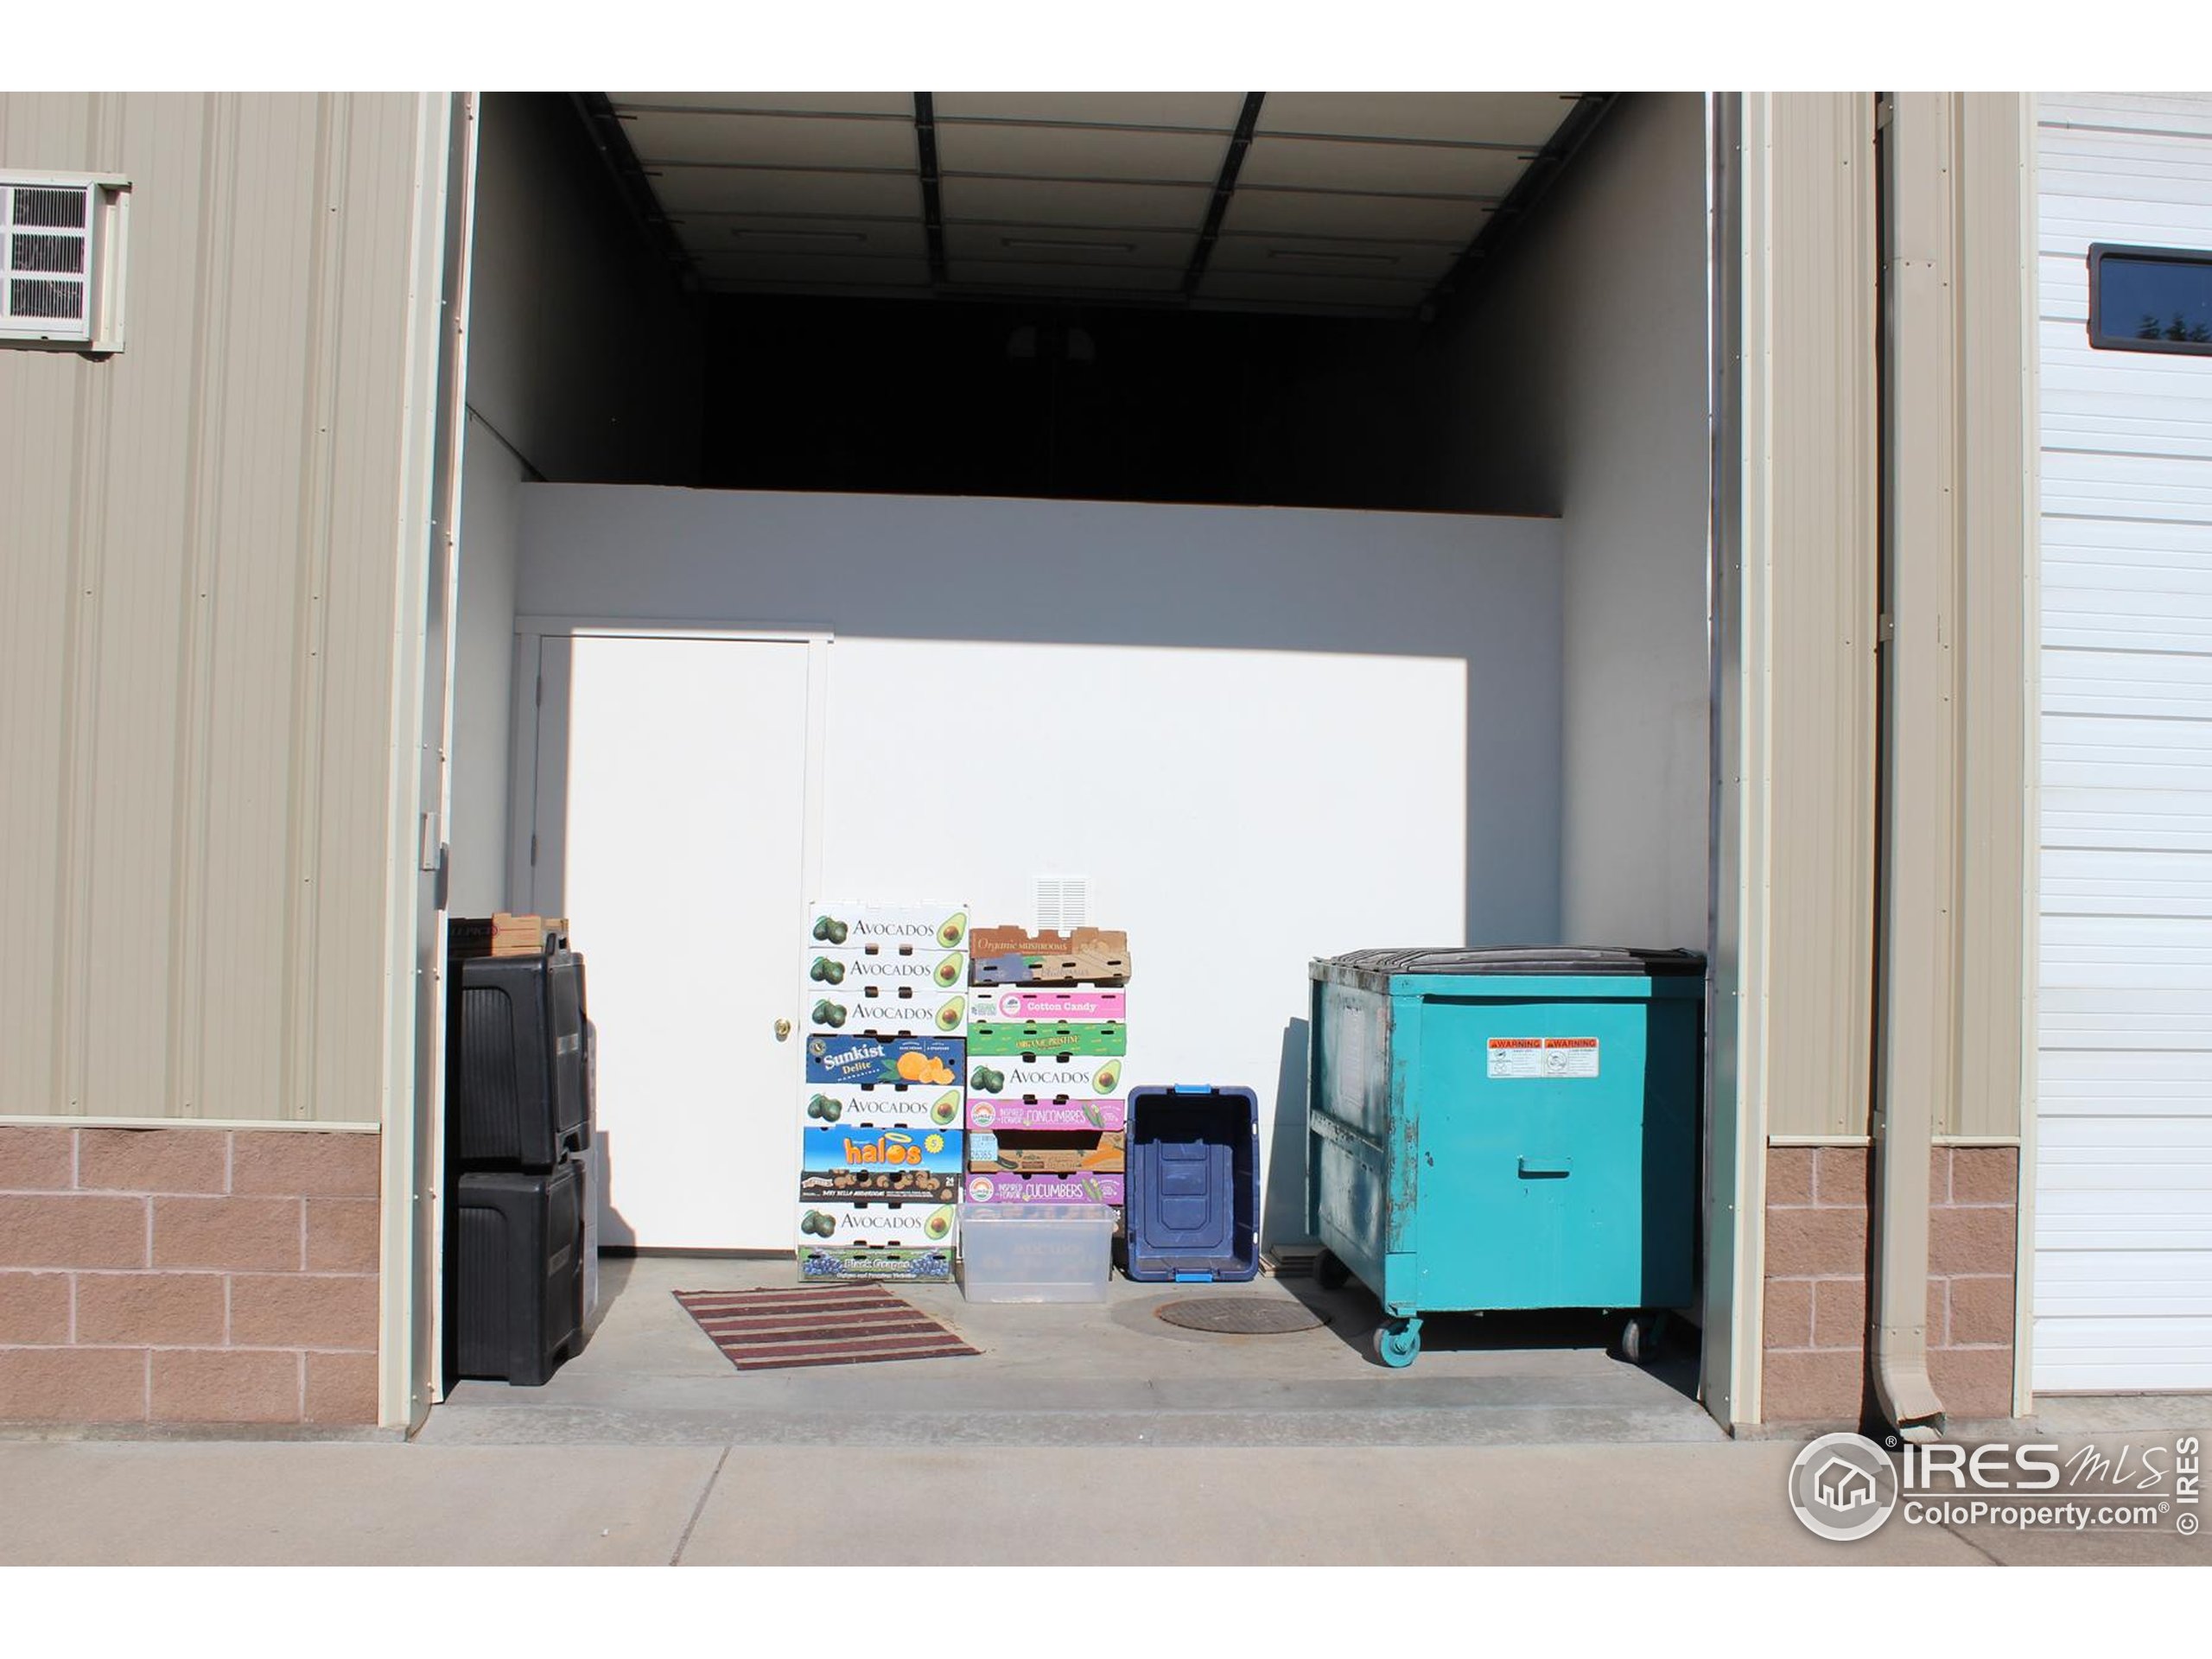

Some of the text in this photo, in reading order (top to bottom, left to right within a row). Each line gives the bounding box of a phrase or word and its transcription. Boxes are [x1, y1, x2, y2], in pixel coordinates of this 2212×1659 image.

[853, 918, 935, 937] AVOCADOS
[977, 938, 1018, 951] Organic
[850, 959, 931, 977] AVOCADOS
[852, 1003, 933, 1020] AVOCADOS
[1027, 1001, 1061, 1012] Cotton
[1063, 1001, 1097, 1013] Candy
[1497, 1039, 1541, 1048] WARNING
[1554, 1039, 1596, 1047] WARNING
[823, 1044, 886, 1071] Sunkist
[842, 1062, 872, 1075] Delite
[1010, 1068, 1090, 1084] AVOCADOS
[847, 1096, 928, 1115] AVOCADOS
[1027, 1109, 1086, 1123] CONCOMBRES
[843, 1136, 923, 1165] halos
[1026, 1183, 1084, 1198] CUCUMBERS
[842, 1212, 922, 1230] AVOCADOS
